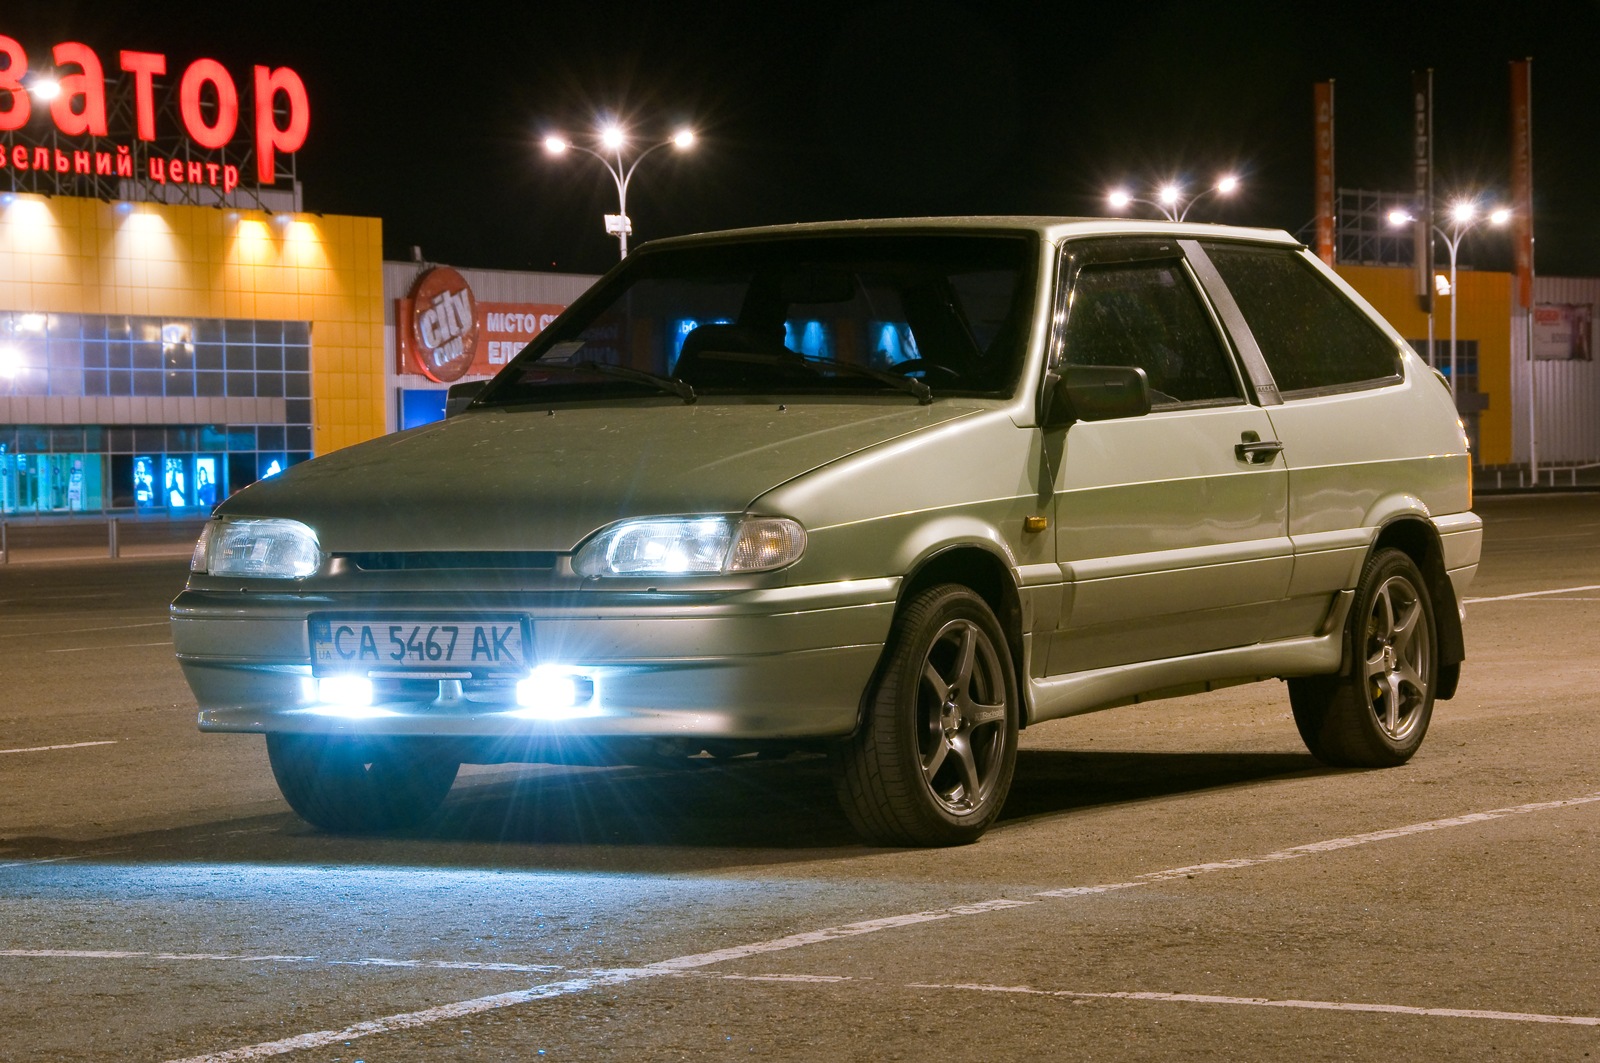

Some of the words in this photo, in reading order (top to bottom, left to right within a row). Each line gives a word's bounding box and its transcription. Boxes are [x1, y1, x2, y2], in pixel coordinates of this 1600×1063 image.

[150, 157, 238, 194] центр
[420, 288, 472, 349] city
[487, 312, 536, 333] МІСТО
[318, 650, 332, 660] UA
[334, 625, 380, 660] CA
[389, 625, 459, 661] 5467
[471, 626, 518, 662] AK
